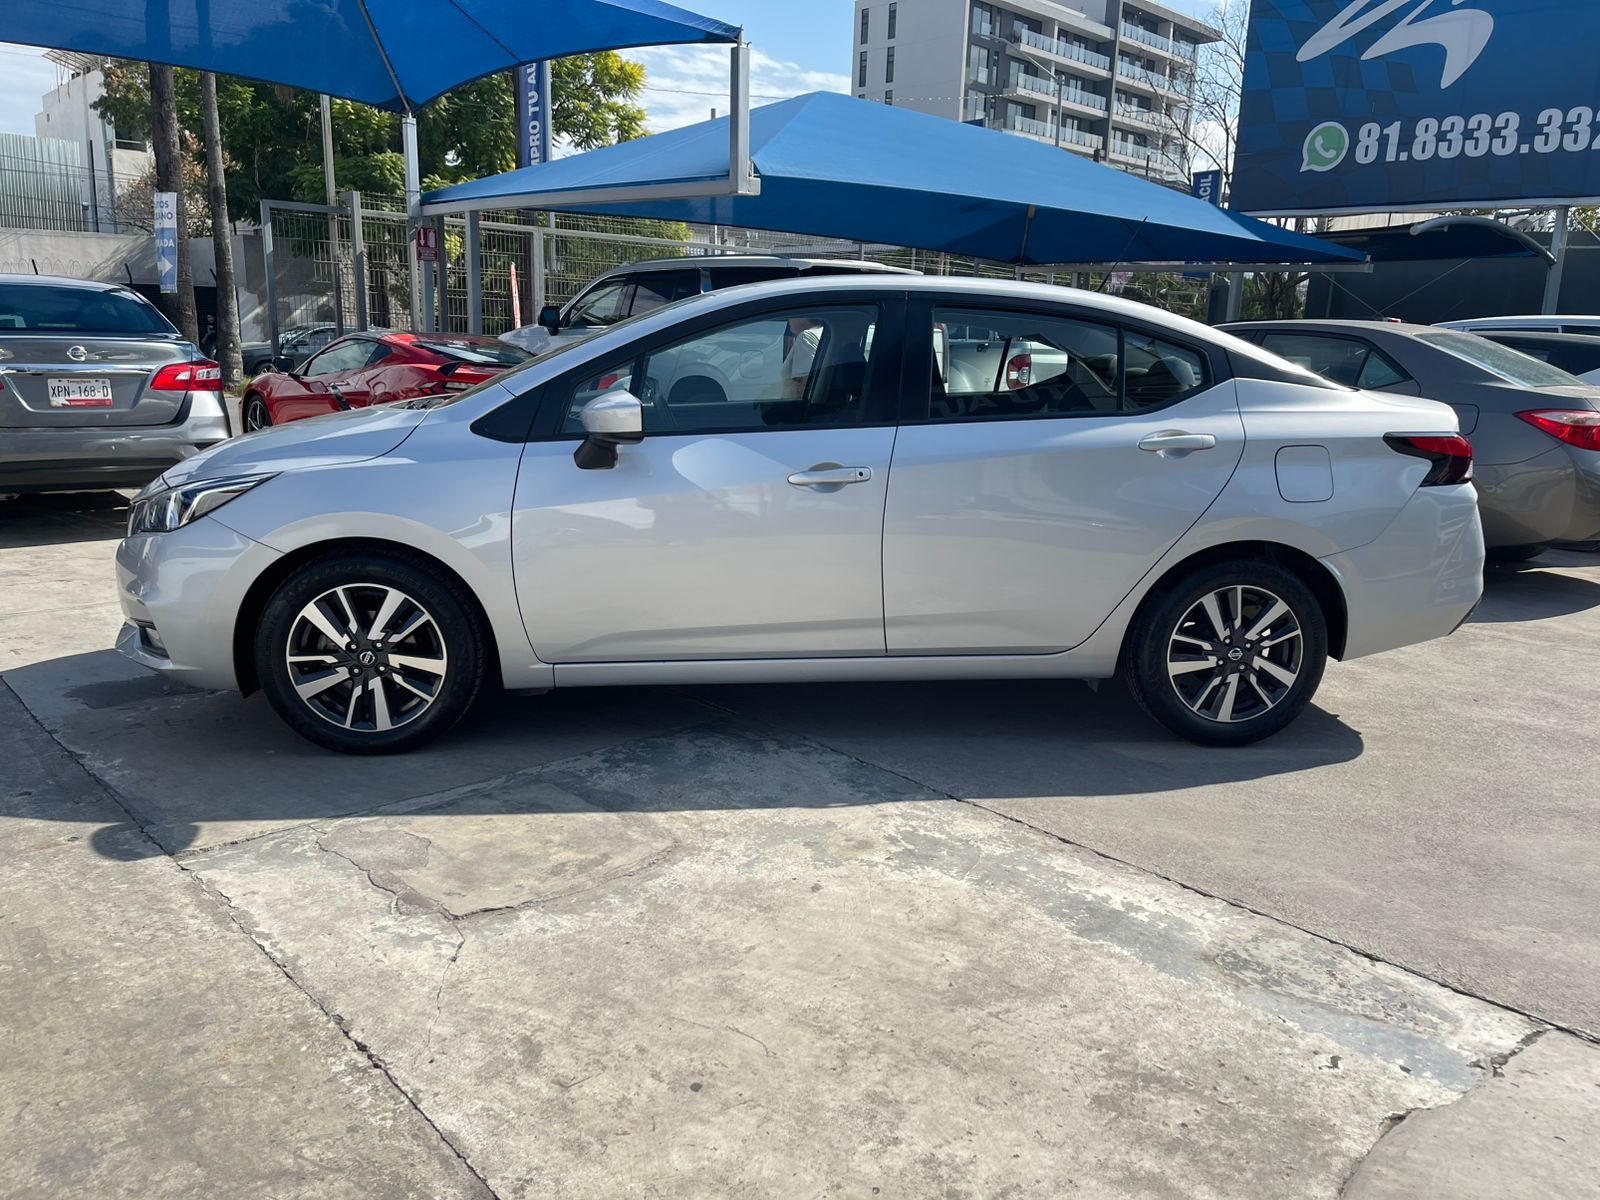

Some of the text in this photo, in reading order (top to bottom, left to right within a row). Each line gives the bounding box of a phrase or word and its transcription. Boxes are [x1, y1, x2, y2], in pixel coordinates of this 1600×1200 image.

[528, 90, 540, 116] TU
[1355, 106, 1600, 165] 81.8333.33
[50, 385, 109, 398] XPN-168-D
